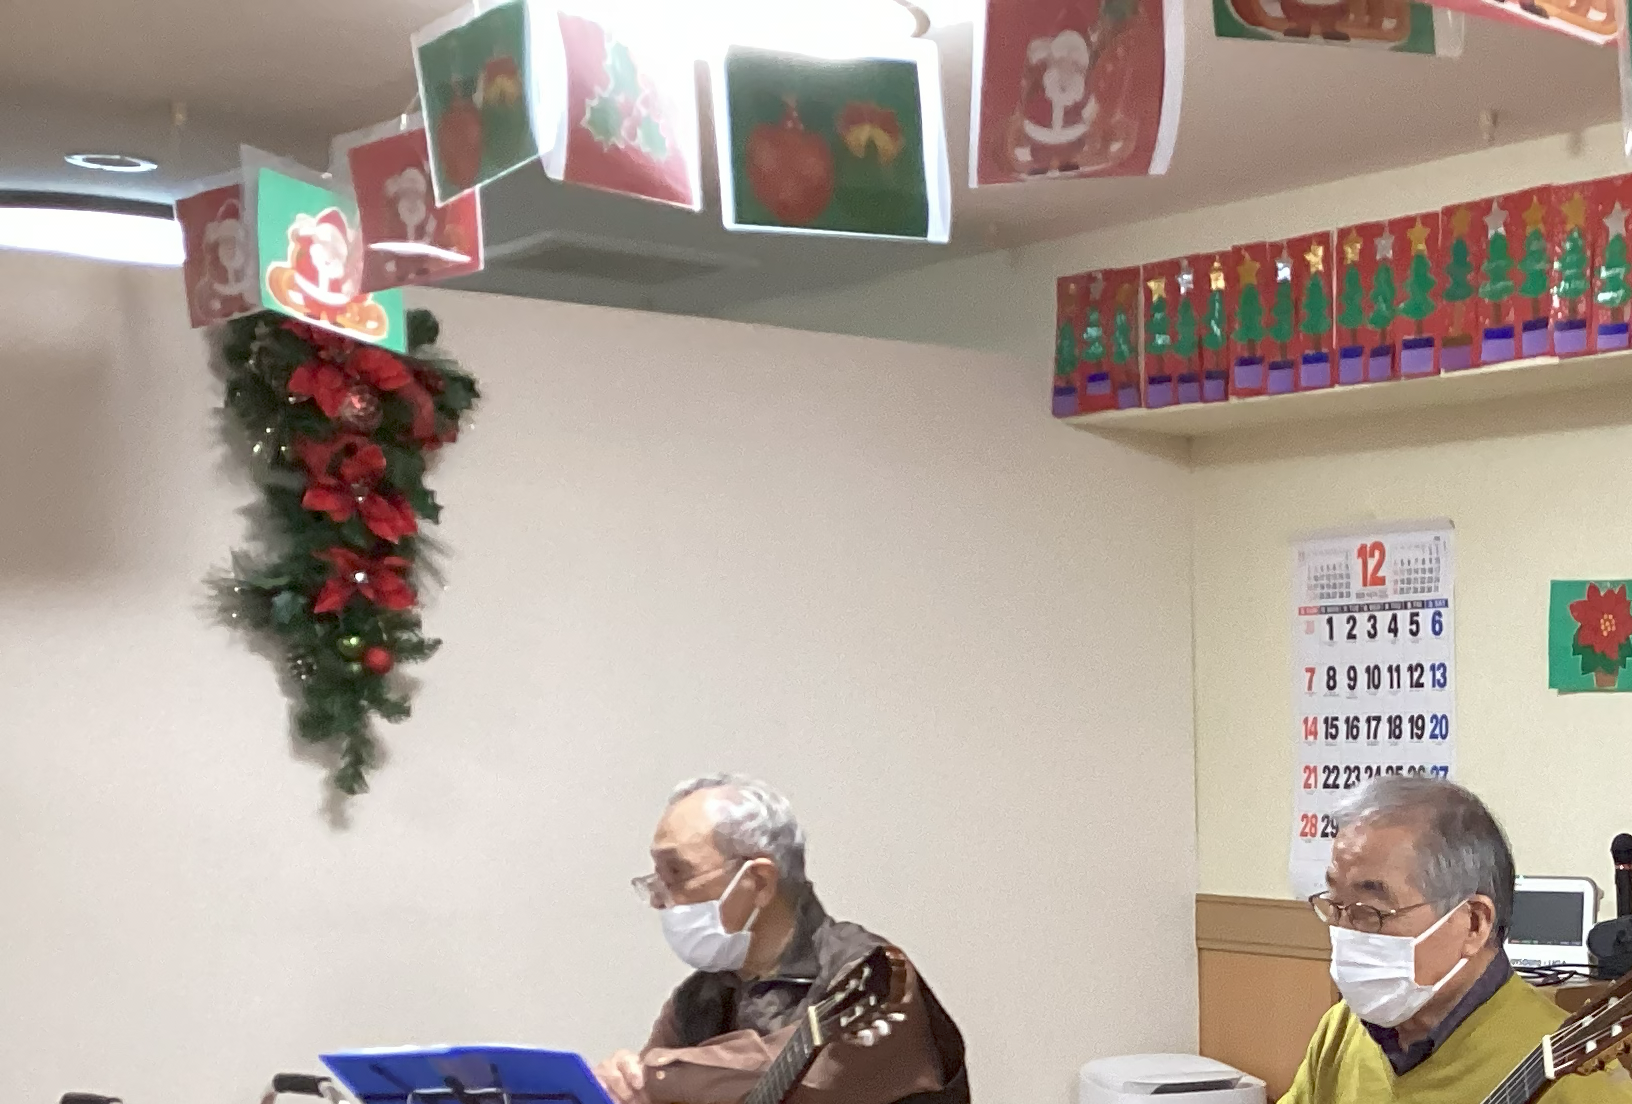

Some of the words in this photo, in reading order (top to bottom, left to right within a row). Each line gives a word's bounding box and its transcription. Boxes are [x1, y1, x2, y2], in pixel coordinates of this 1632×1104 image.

[1357, 541, 1386, 587] 12
[1326, 616, 1334, 640] 1
[1346, 615, 1357, 640] 2
[1367, 614, 1378, 639] 3
[1388, 613, 1399, 638] 4
[1408, 612, 1420, 637] 5
[1431, 610, 1443, 636] 6
[1304, 667, 1316, 691] 7
[1326, 666, 1337, 691] 8
[1347, 665, 1358, 690] 9
[1365, 664, 1382, 690] 10
[1387, 664, 1401, 689] 11
[1407, 662, 1425, 688] 12
[1430, 662, 1447, 688] 13
[1303, 716, 1318, 740] 14
[1323, 716, 1339, 740] 15
[1344, 715, 1360, 740] 16
[1365, 715, 1382, 740] 17
[1386, 714, 1403, 740] 18
[1408, 714, 1425, 740] 19
[1429, 713, 1449, 740] 20
[1303, 765, 1318, 789] 21
[1322, 765, 1340, 789] 22
[1343, 765, 1361, 789] 23
[1300, 813, 1318, 838] 28
[1321, 814, 1339, 838] 29
